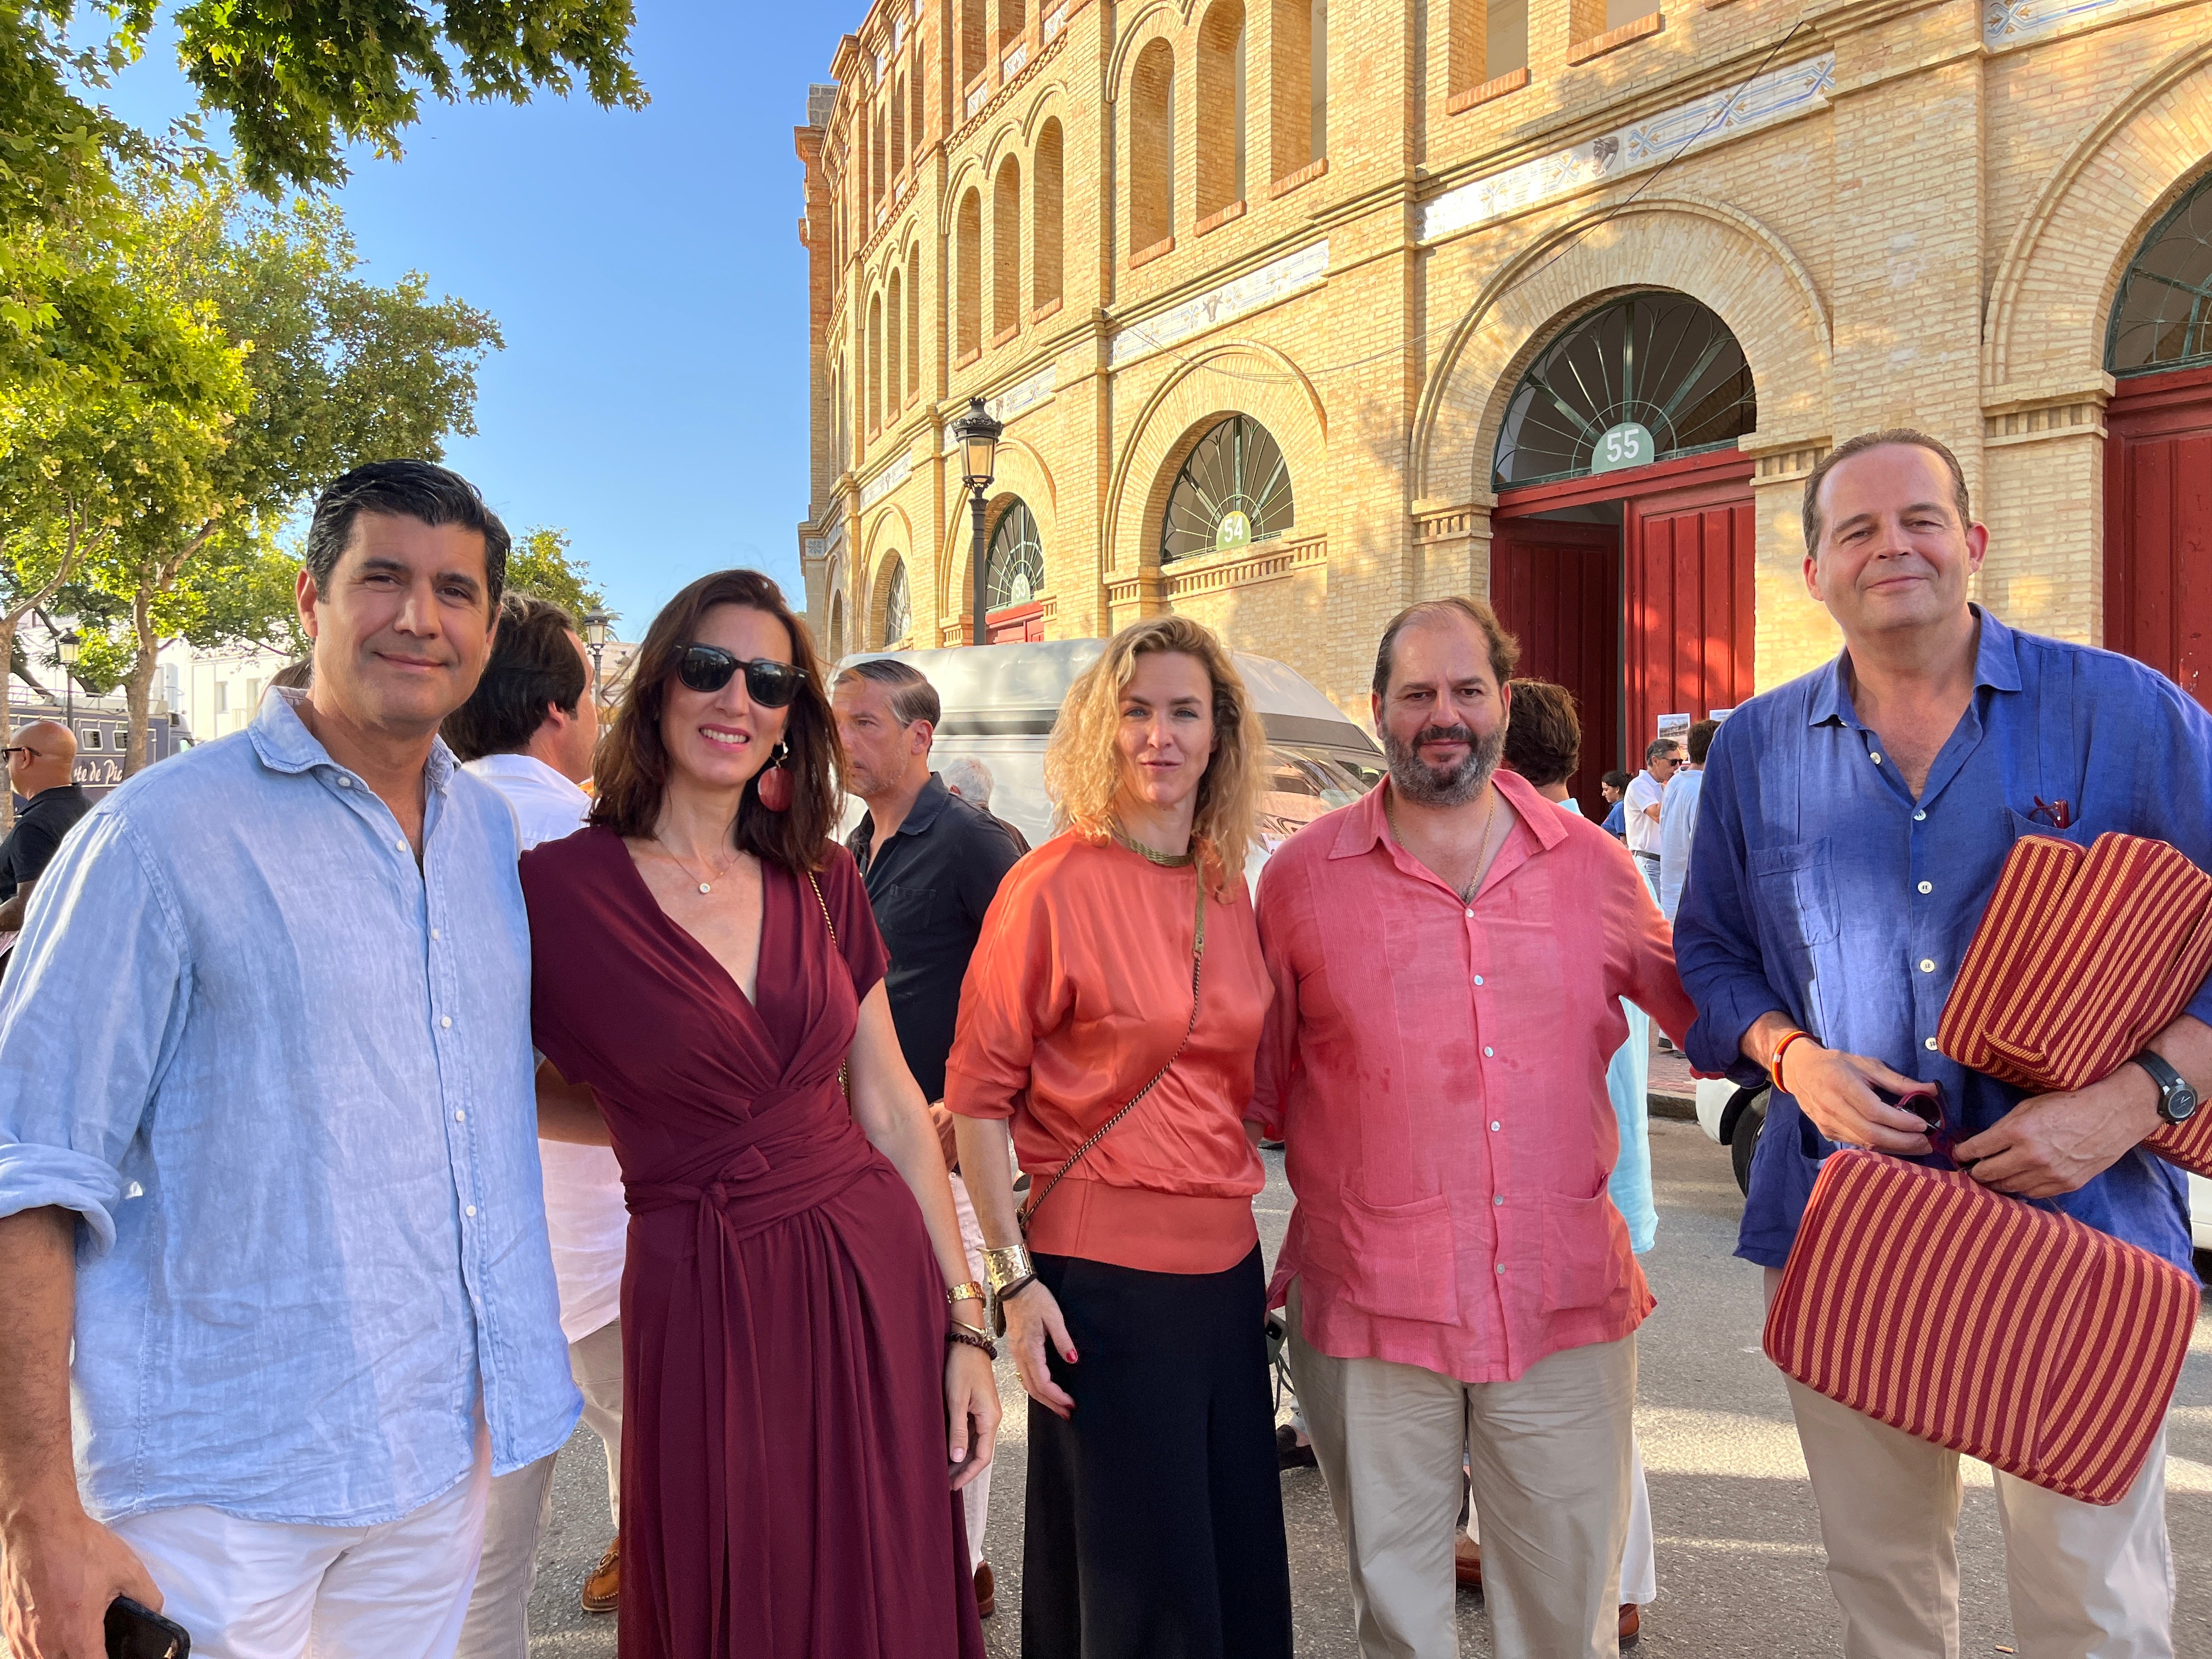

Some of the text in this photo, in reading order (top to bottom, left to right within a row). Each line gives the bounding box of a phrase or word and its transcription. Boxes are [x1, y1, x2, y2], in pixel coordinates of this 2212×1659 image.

[1607, 428, 1639, 462] 55
[1224, 516, 1243, 543] 54
[1015, 578, 1026, 599] 53
[89, 761, 101, 782] de
